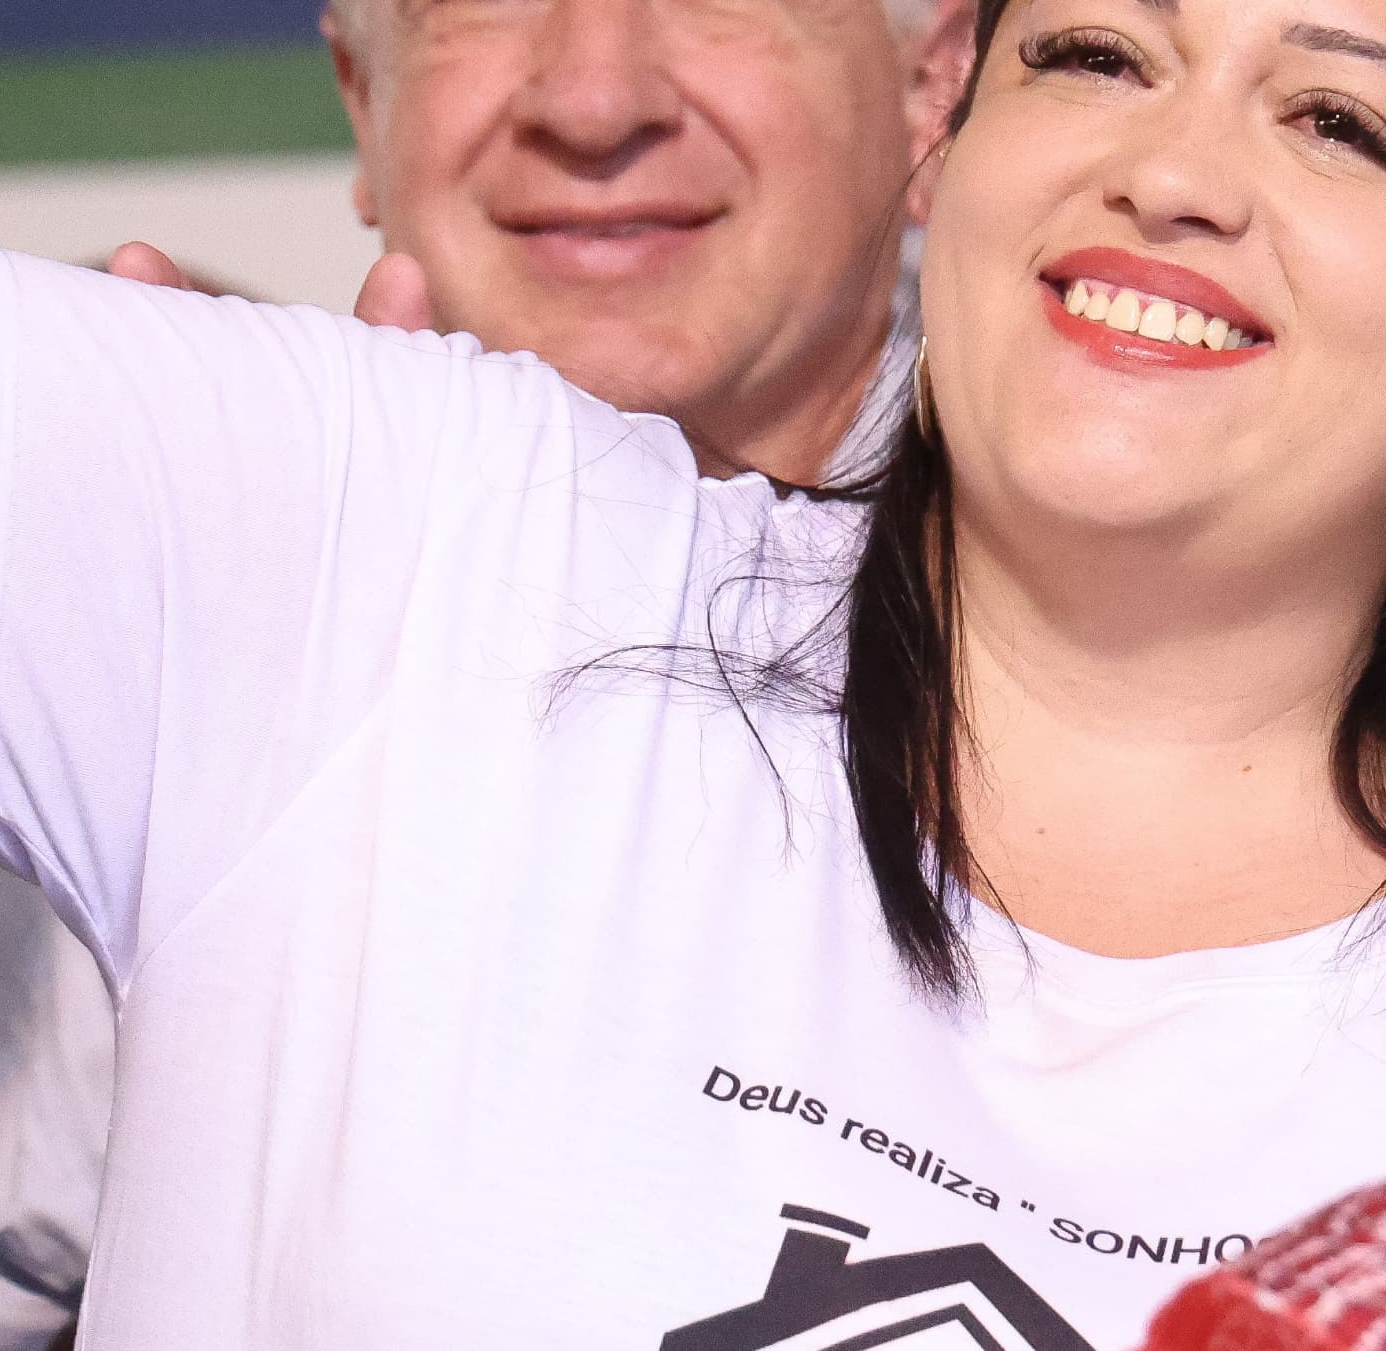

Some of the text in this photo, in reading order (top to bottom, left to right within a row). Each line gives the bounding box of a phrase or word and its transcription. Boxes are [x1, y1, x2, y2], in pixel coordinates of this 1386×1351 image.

[702, 1065, 828, 1125] Deus
[840, 1118, 1001, 1211] realiza
[1049, 1217, 1268, 1265] SONHO
